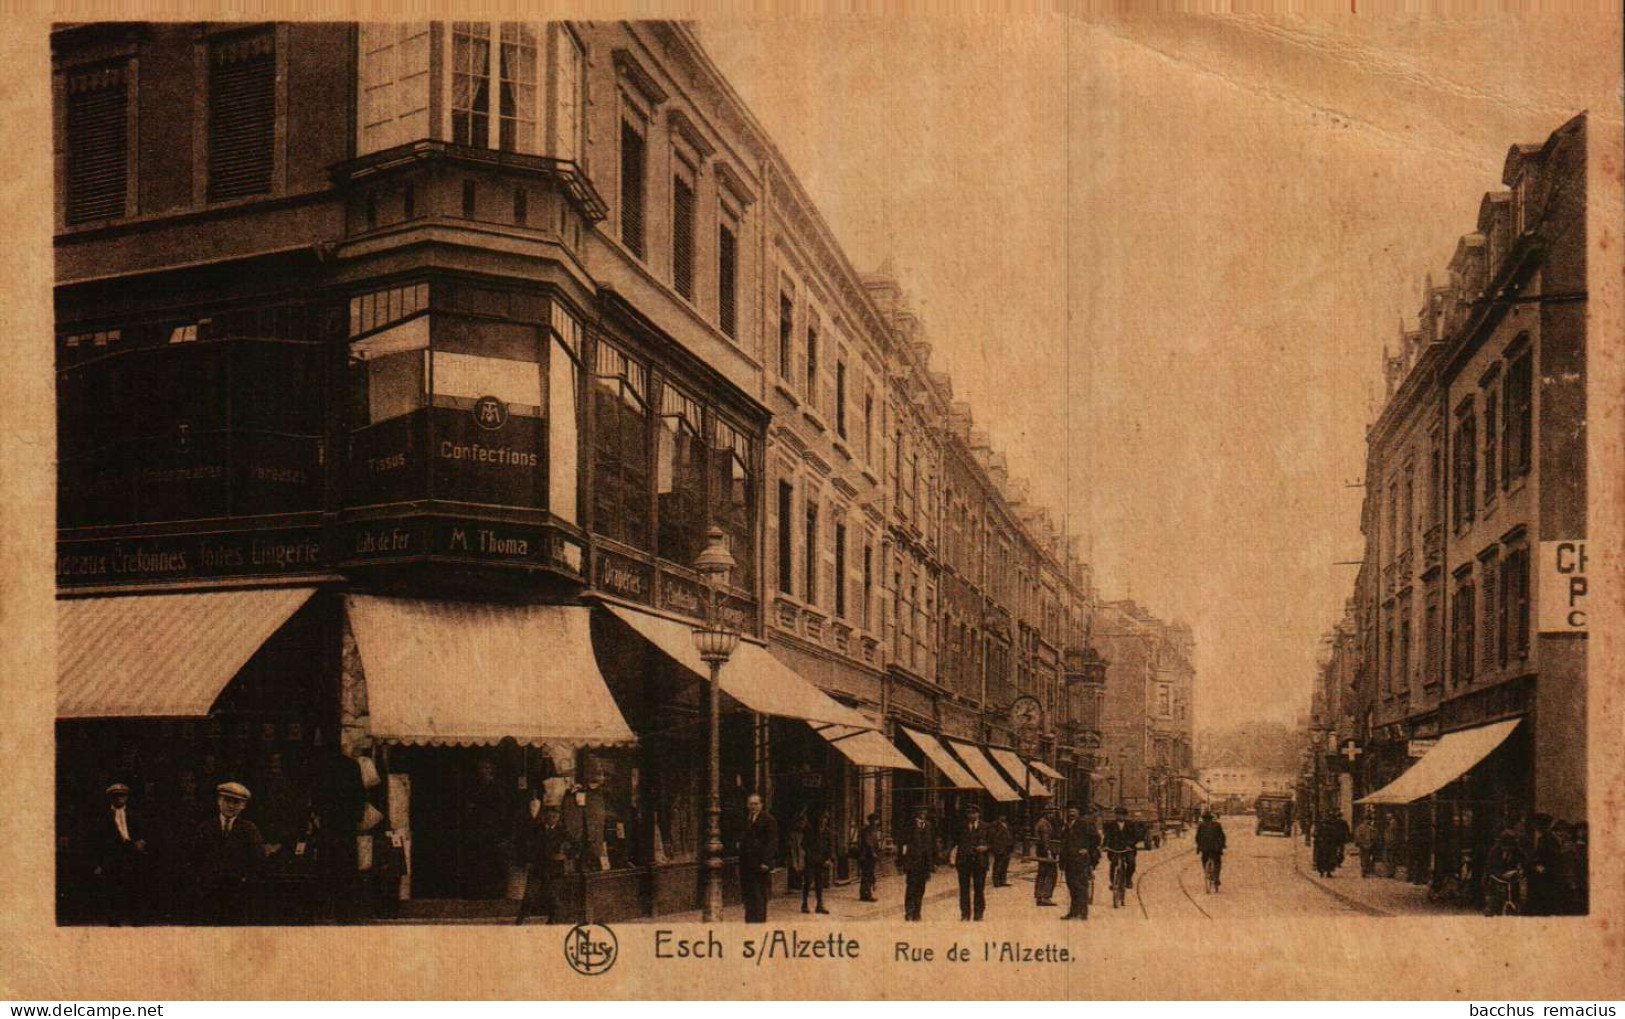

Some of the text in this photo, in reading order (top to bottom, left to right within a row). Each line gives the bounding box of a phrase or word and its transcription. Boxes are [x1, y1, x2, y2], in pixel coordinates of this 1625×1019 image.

[440, 441, 538, 467] Confections
[392, 528, 410, 551] Fer
[477, 529, 529, 556] Thoma
[251, 539, 320, 568] Lingerie
